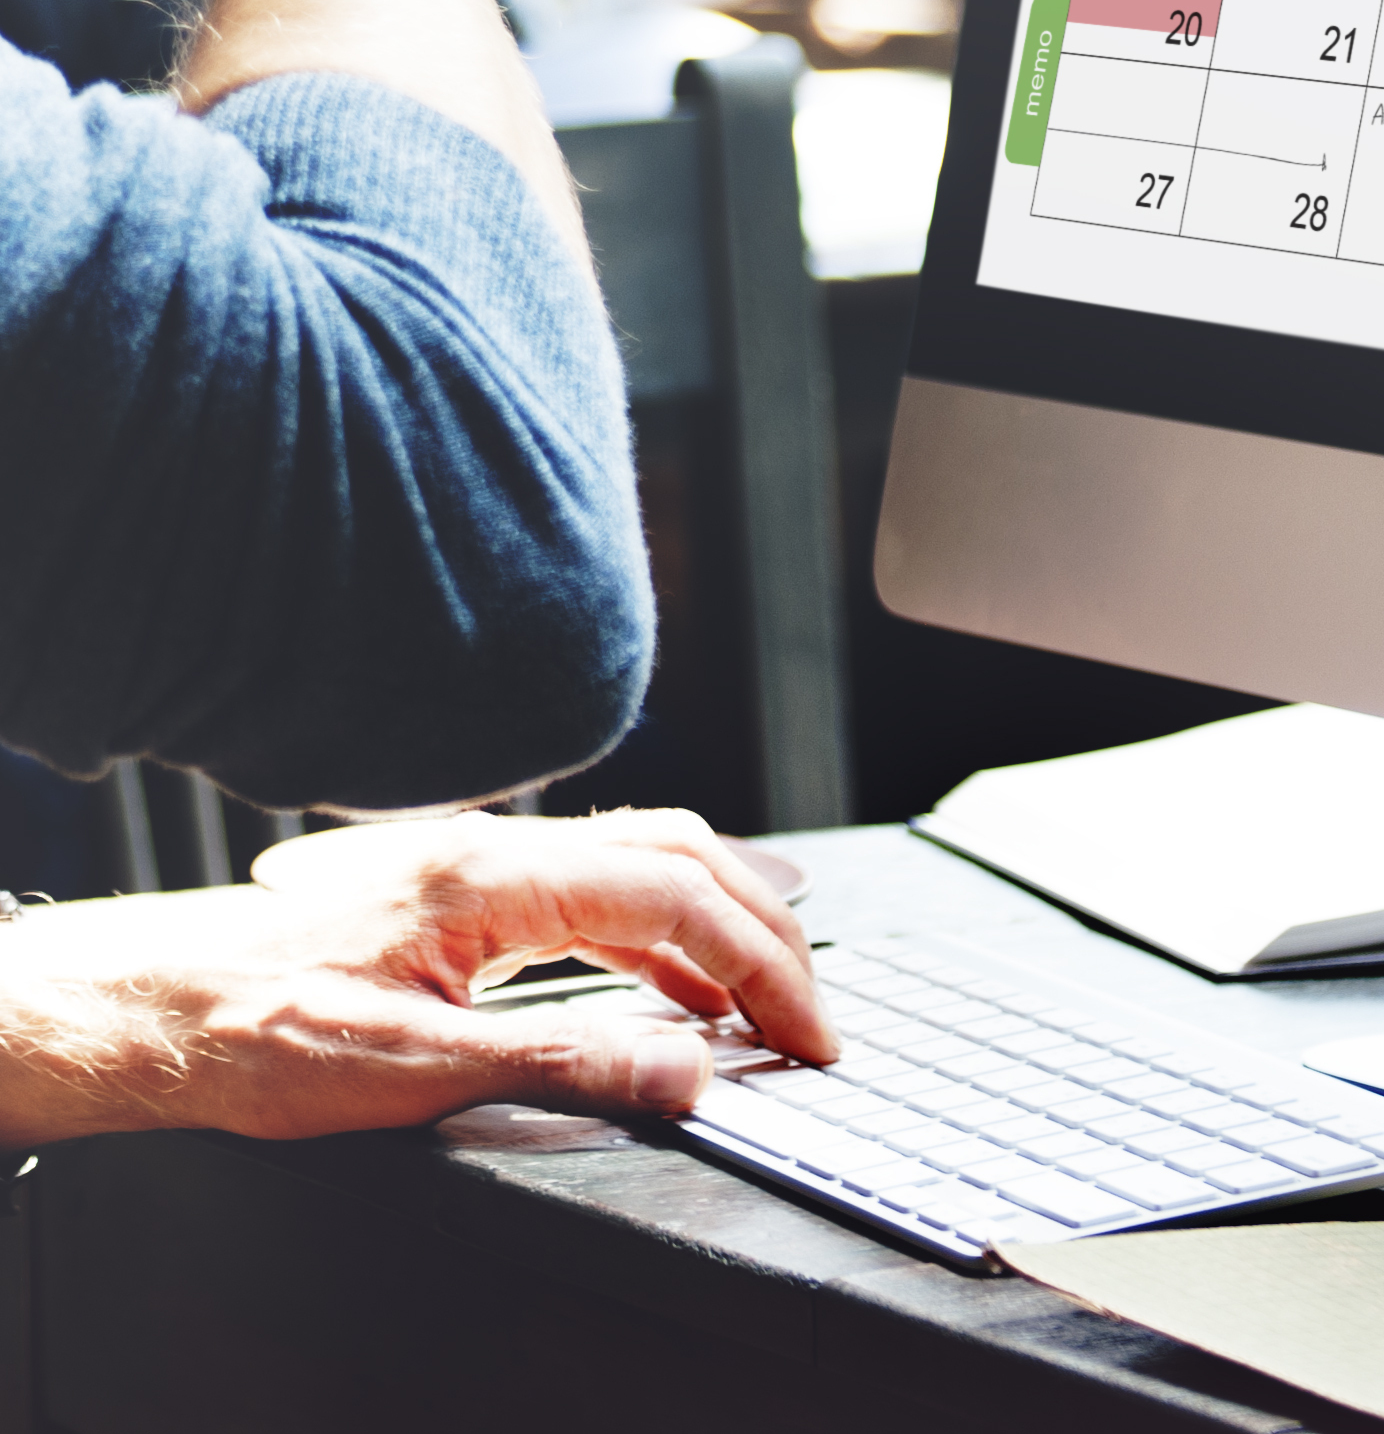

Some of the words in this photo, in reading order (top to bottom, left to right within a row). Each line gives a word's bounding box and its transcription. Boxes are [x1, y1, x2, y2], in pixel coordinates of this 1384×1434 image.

[1165, 9, 1203, 47] 20
[1319, 25, 1356, 64] 21
[1026, 30, 1053, 117] memo
[1135, 172, 1175, 210] 27
[1290, 192, 1329, 232] 28
